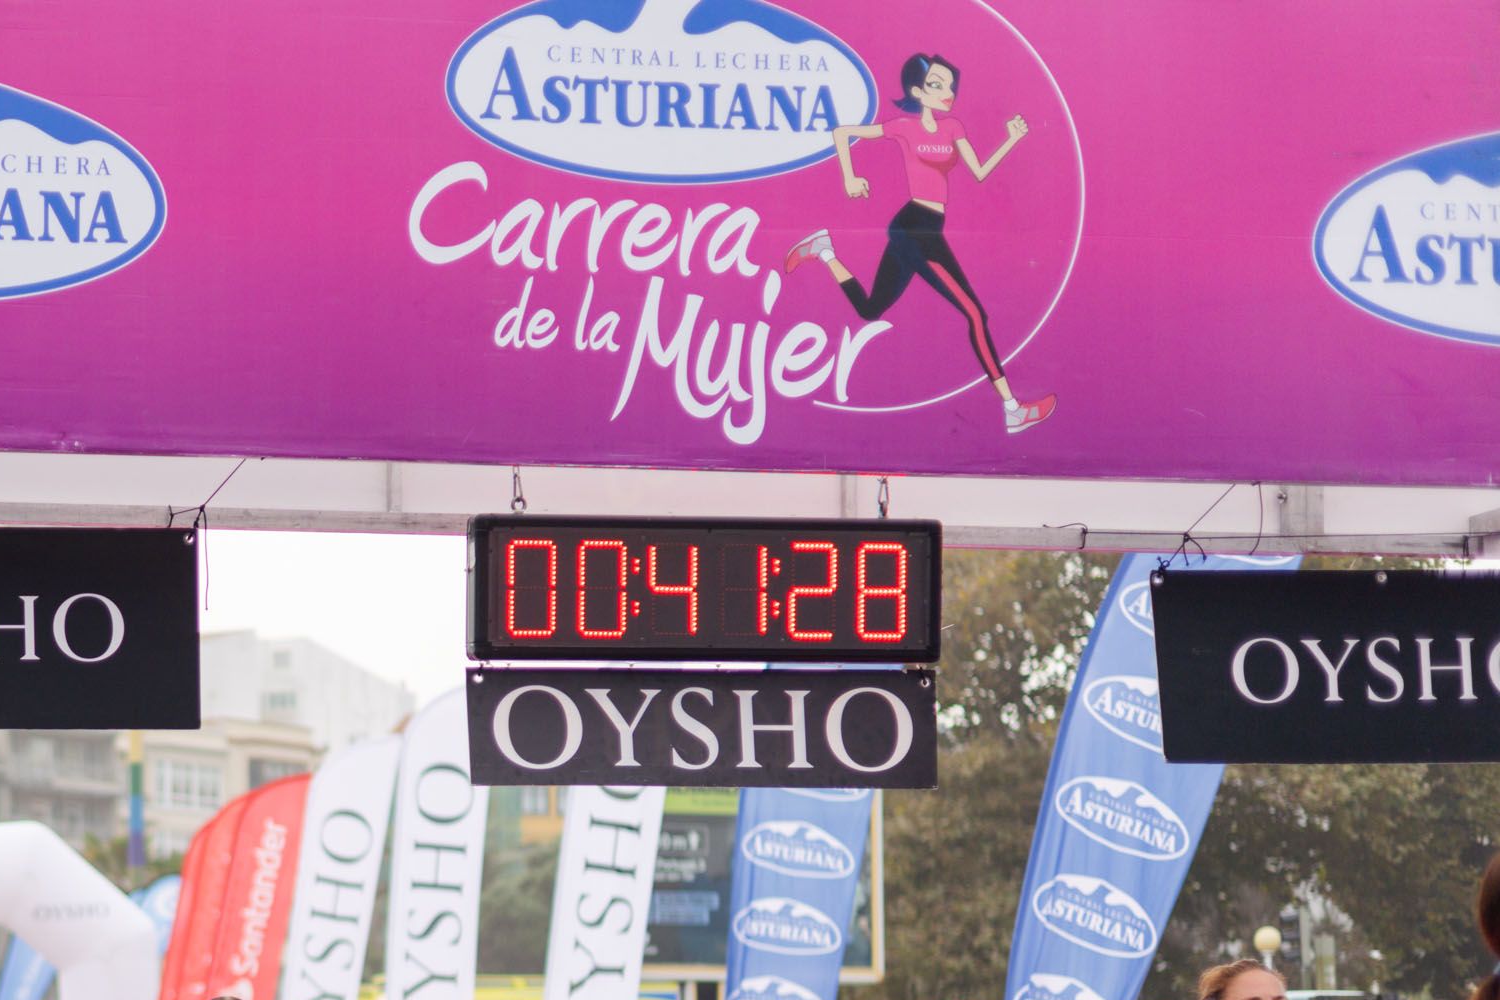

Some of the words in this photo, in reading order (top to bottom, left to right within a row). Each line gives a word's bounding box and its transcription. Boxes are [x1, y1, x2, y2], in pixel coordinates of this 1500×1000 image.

[478, 46, 840, 133] ASTURIANA
[546, 44, 681, 68] CENTRAL
[695, 50, 830, 74] LECHERA
[917, 145, 954, 153] OYSHO
[408, 160, 762, 278] Carrera
[493, 275, 560, 352] de
[574, 275, 621, 354] la
[610, 268, 894, 445] Mujer
[506, 539, 908, 642] 00:41:28
[1231, 637, 1500, 704] OYSH
[492, 684, 914, 774] OYSHO
[1064, 785, 1177, 854] ASTURIANA
[230, 817, 288, 976] Santander
